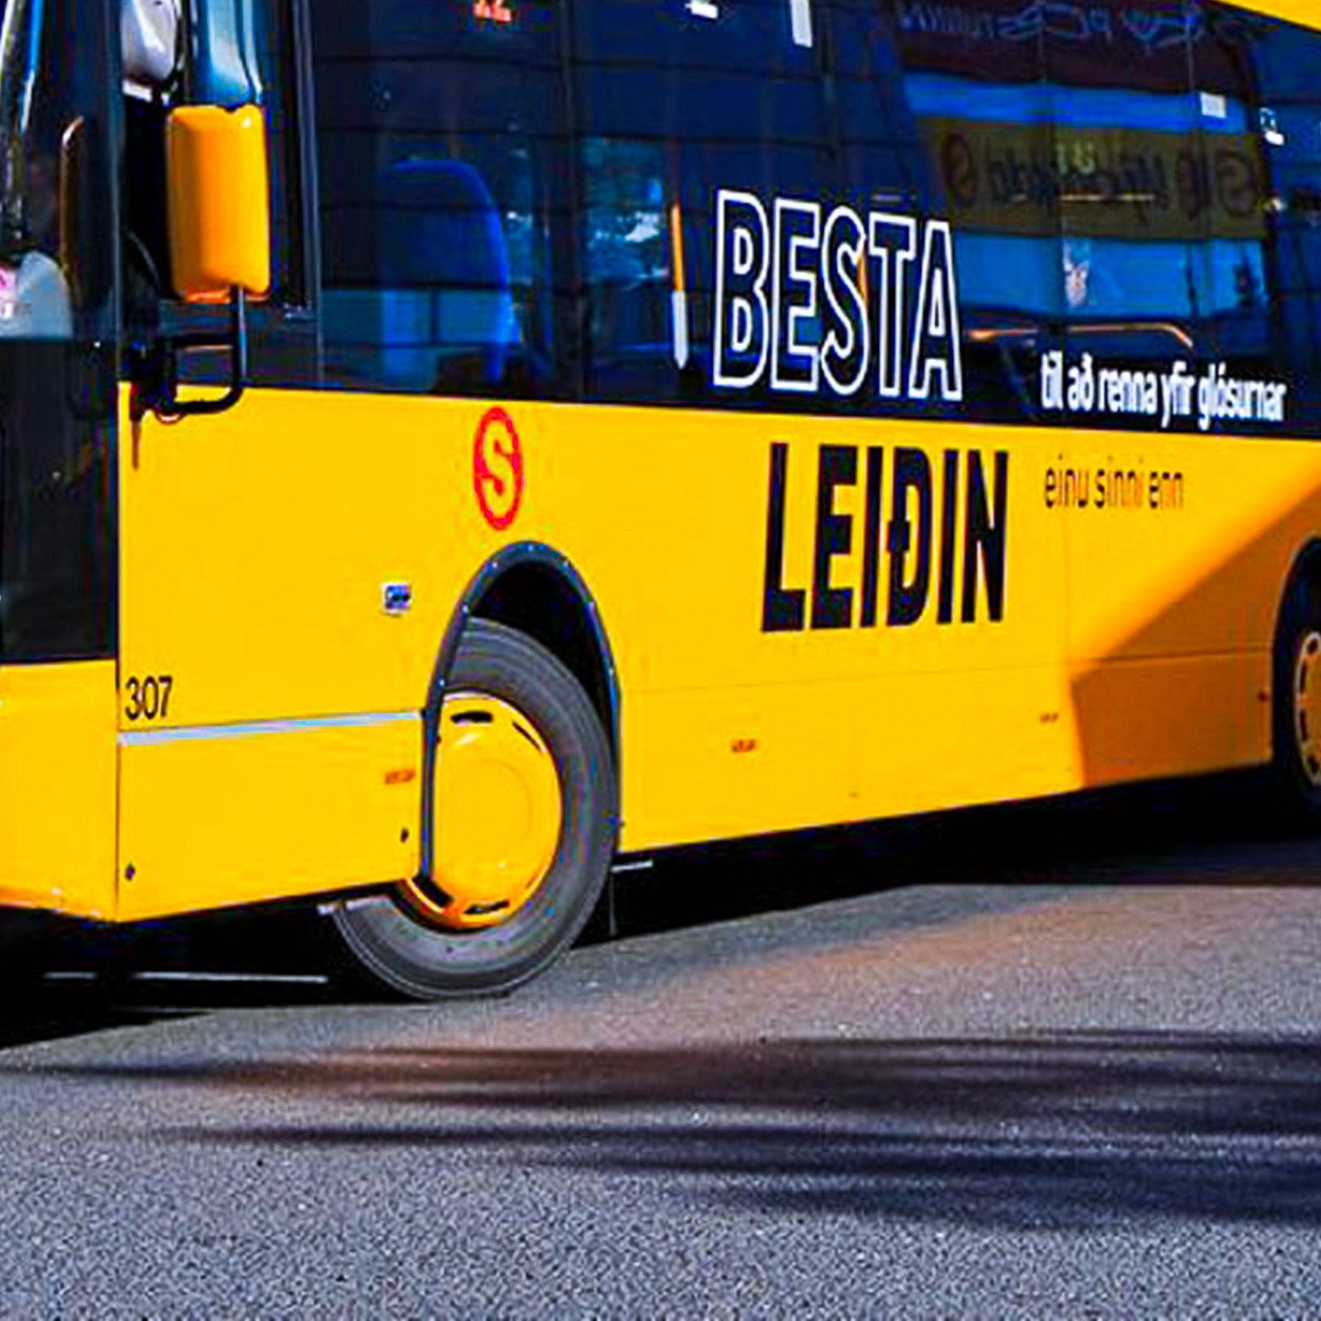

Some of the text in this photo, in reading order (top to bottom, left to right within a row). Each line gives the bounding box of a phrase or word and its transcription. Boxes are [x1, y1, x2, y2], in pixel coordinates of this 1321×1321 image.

[711, 188, 964, 401] BESTA
[1040, 350, 1064, 410] til
[1067, 352, 1095, 412] að
[1097, 368, 1158, 415] renna
[1161, 360, 1196, 428] yfir
[761, 441, 1009, 633] LEIÐIN
[124, 676, 173, 721] 307
